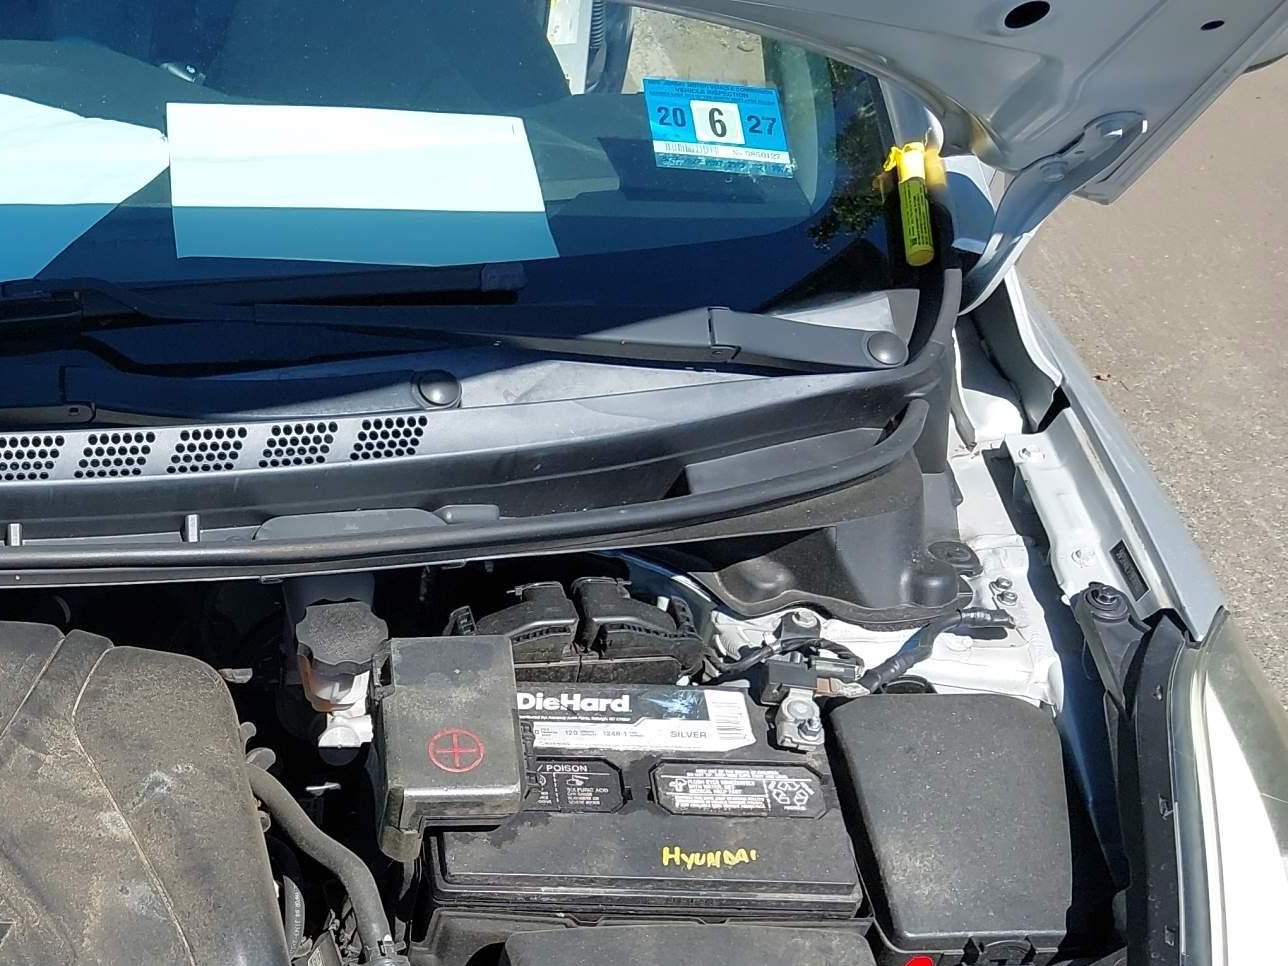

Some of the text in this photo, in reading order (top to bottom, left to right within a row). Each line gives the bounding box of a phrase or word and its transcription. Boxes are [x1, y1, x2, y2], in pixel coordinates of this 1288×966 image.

[657, 106, 777, 138] 20 6 27
[670, 731, 707, 739] SILVER
[546, 764, 588, 772] POISON
